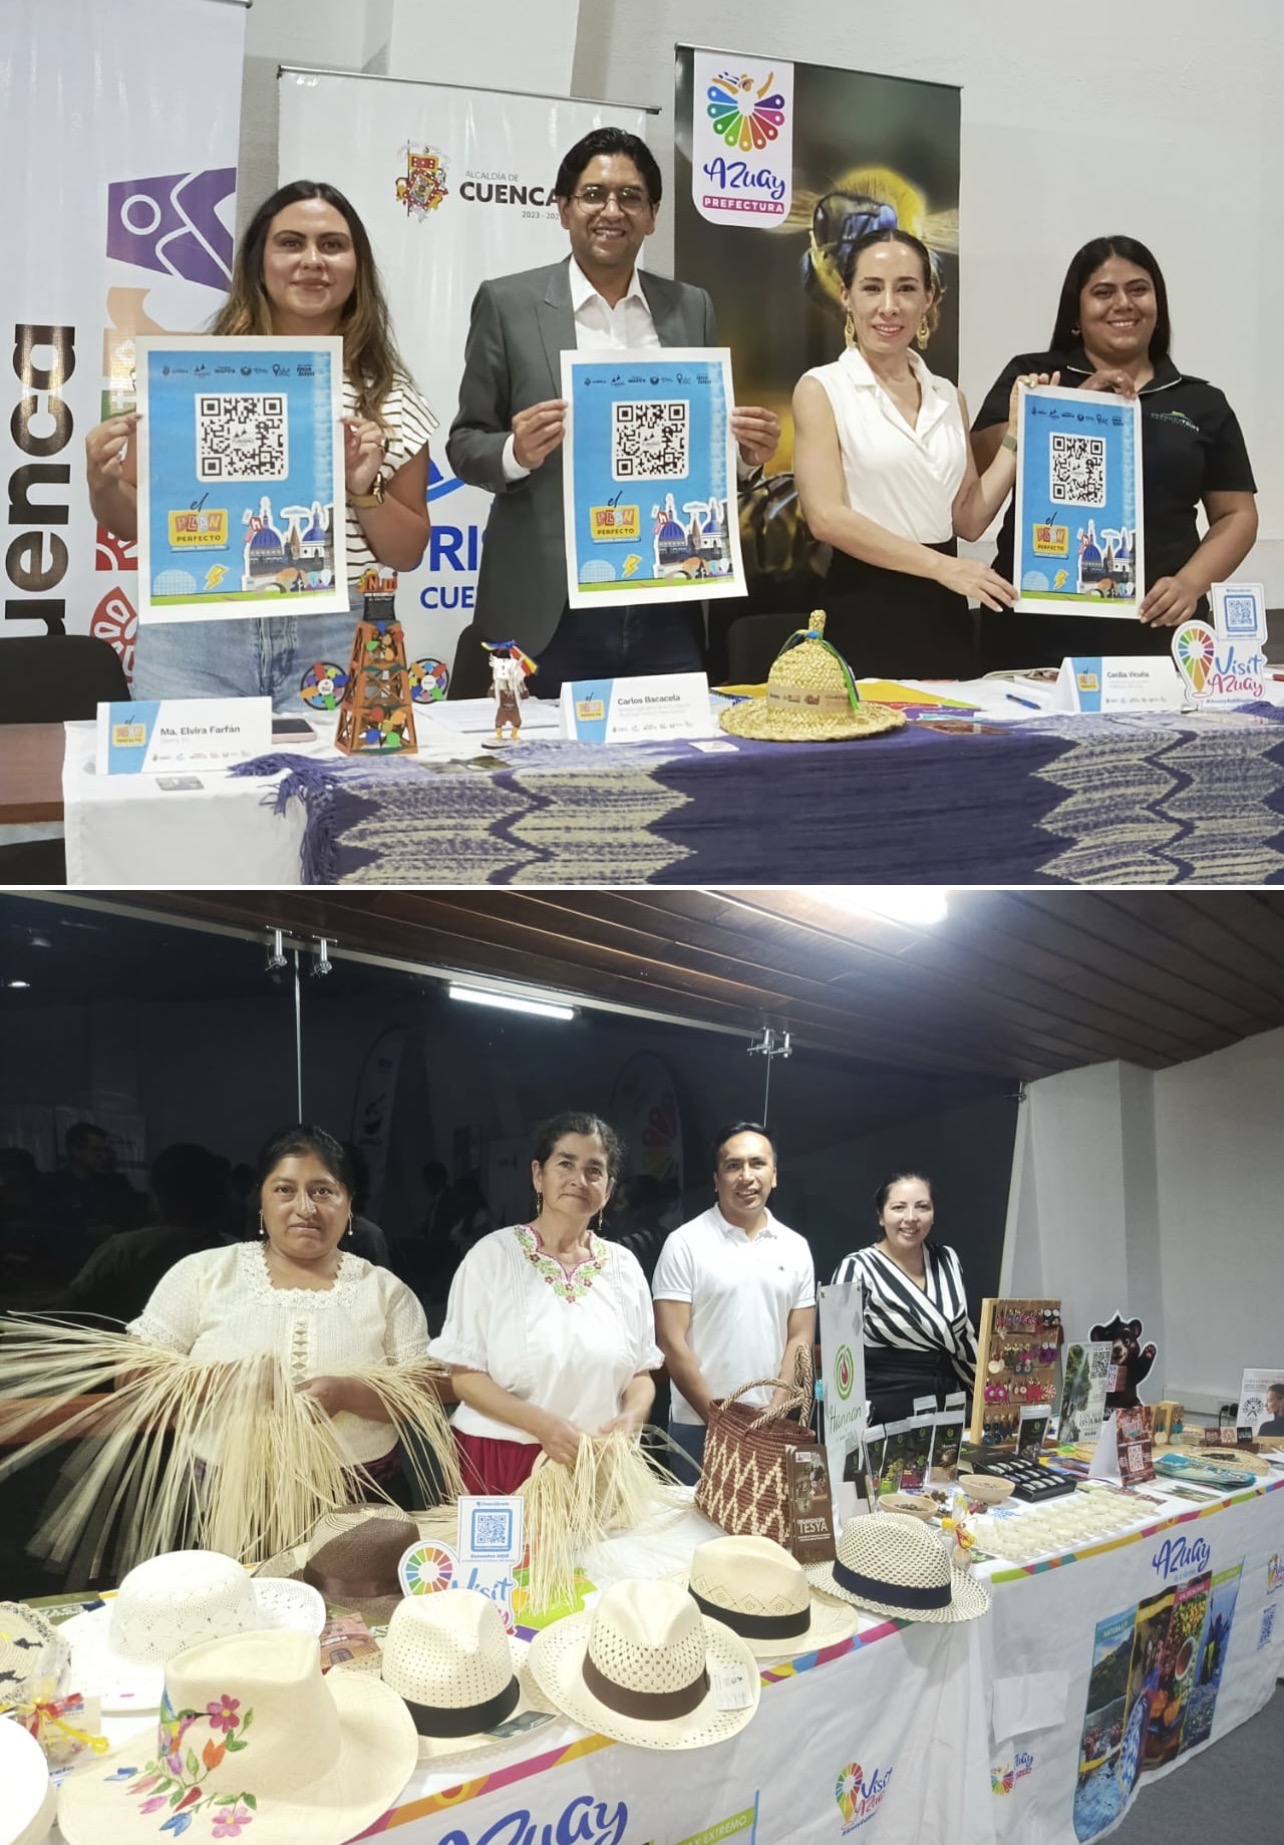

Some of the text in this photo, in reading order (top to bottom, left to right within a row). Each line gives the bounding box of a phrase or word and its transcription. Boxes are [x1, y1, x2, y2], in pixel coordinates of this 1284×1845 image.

[465, 170, 519, 182] ALCALDÍA DE
[704, 197, 784, 213] PREFECTURA
[521, 210, 540, 219] 2023
[546, 212, 560, 220] 202
[5, 323, 75, 637] uenca
[176, 534, 222, 543] PERFECTO
[420, 586, 475, 609] CUE
[1215, 646, 1262, 675] Visit
[617, 694, 681, 706] Carlos Bacacela
[160, 725, 240, 736] Ma. Elvira Farfán
[703, 1815, 747, 1844] EXTREMO
